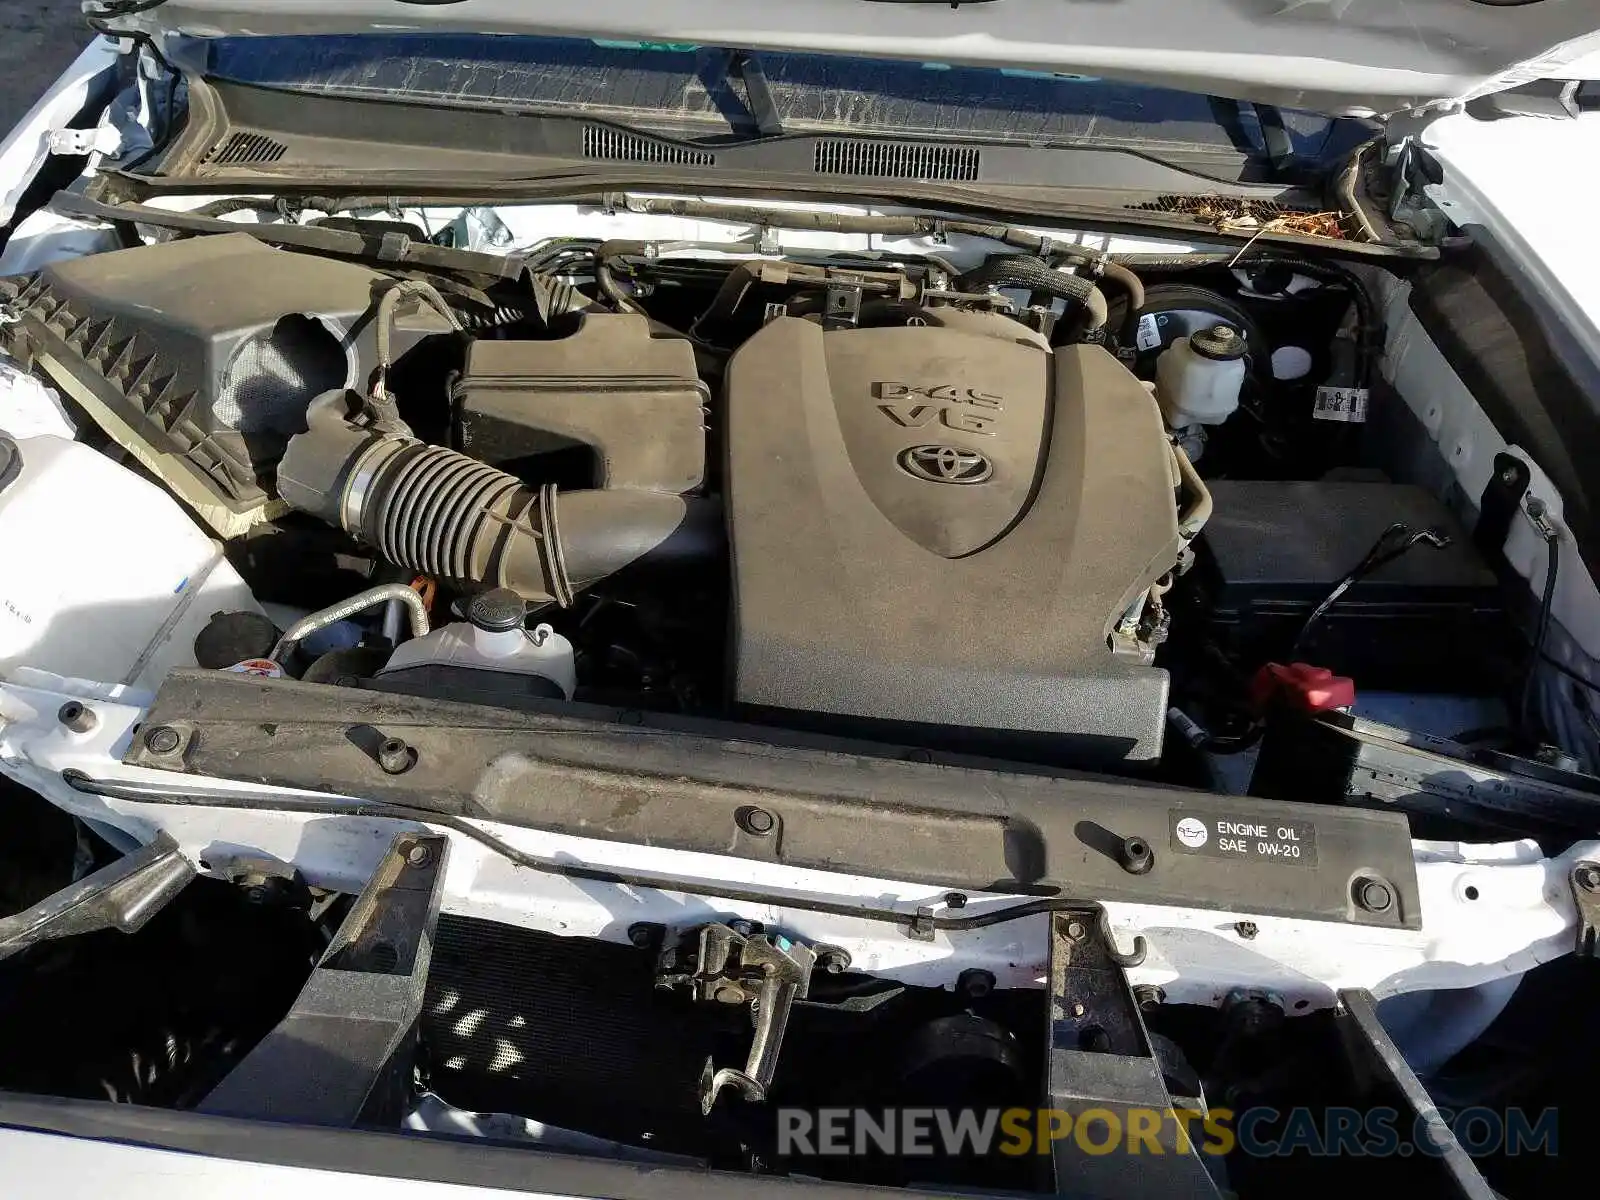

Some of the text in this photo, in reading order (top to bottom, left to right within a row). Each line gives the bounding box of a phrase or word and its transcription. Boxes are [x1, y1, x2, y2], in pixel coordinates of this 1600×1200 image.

[876, 403, 998, 437] V6
[1217, 821, 1300, 841] ENGINE OIL
[1219, 838, 1300, 858] SAE 0W-20
